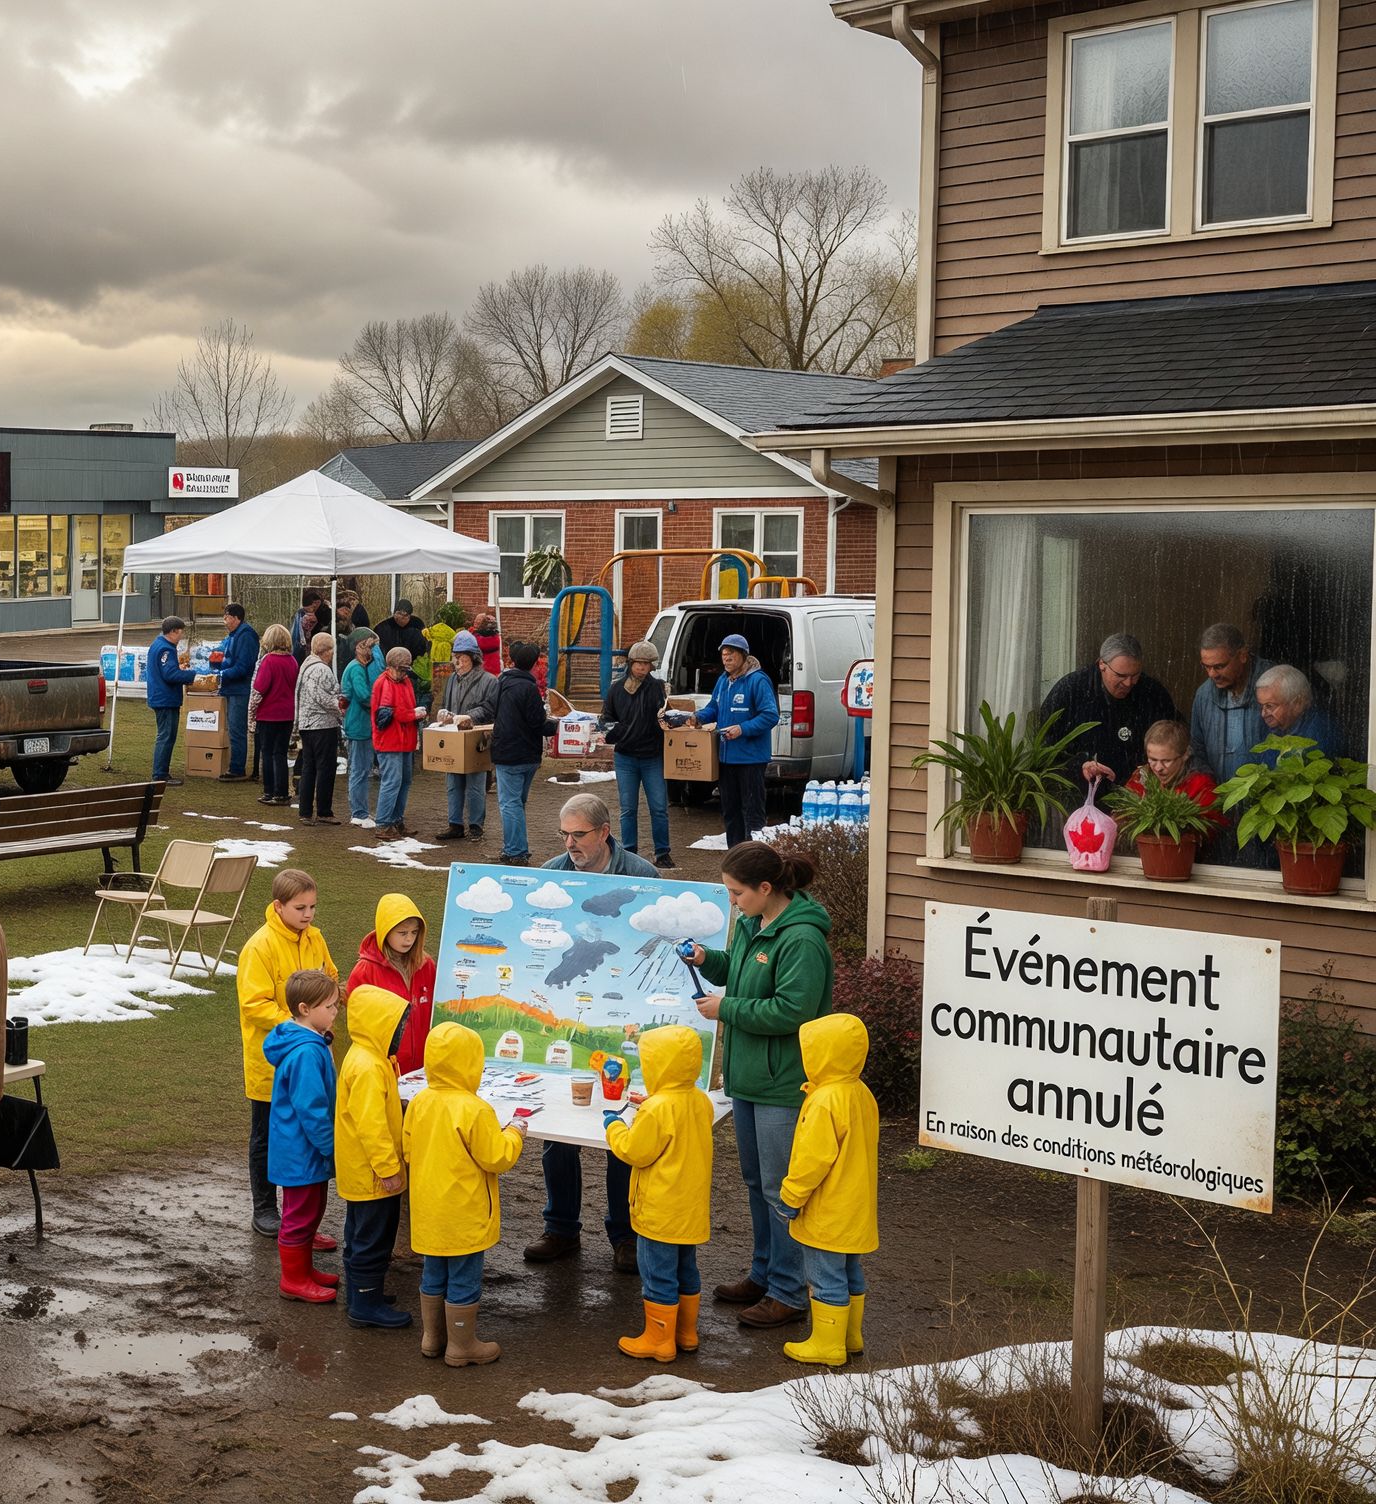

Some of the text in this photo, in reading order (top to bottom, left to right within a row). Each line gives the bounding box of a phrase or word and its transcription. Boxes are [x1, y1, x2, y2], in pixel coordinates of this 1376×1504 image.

[965, 912, 1220, 1011] Événement
[930, 1003, 1267, 1086] communautaire
[1007, 1077, 1165, 1137] annulé
[926, 1110, 1265, 1195] En raison des conditions météorologiques
